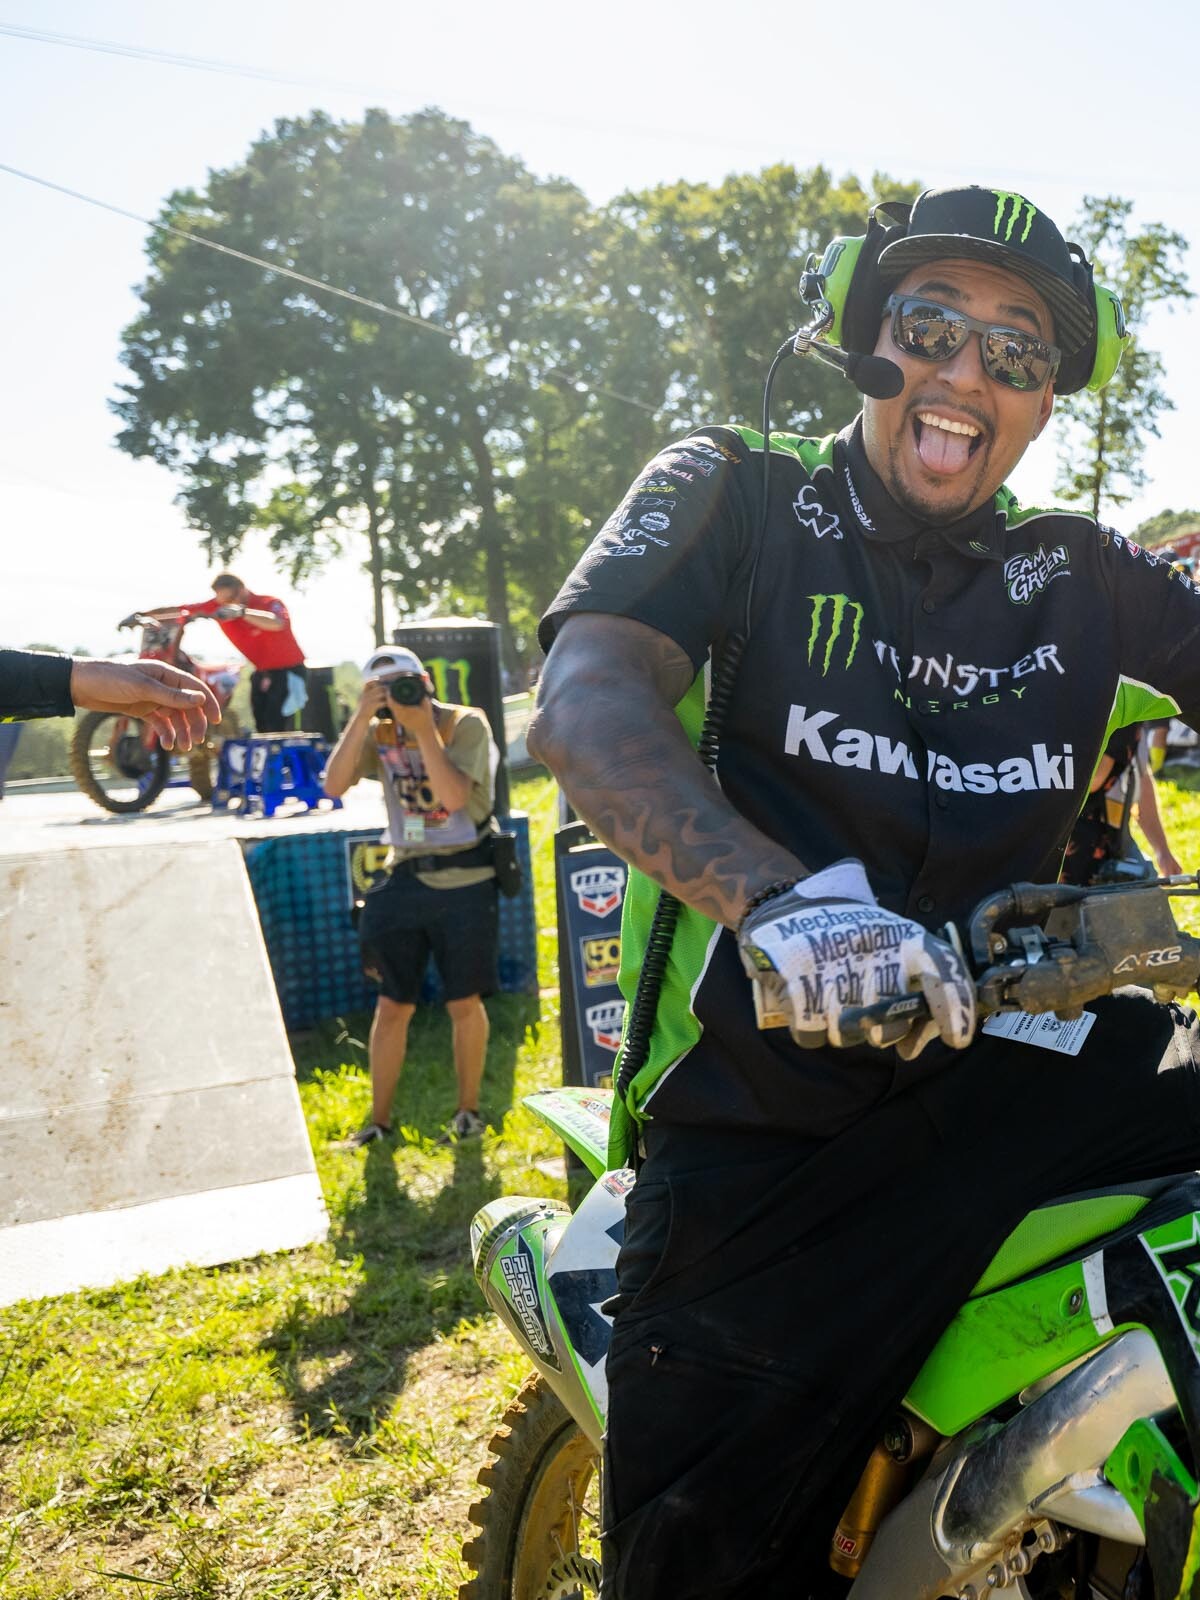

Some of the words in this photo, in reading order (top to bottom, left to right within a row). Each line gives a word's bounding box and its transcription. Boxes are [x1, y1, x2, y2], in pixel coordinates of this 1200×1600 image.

[1004, 546, 1046, 583] TEAM
[1010, 547, 1066, 601] GREEN
[894, 686, 1027, 713] NERGY
[784, 703, 1074, 795] Kawasaki
[774, 907, 892, 941] Mechanix
[804, 921, 922, 964] Mechanix
[1113, 946, 1182, 974] ARC
[799, 962, 900, 1014] Mchnix
[500, 1256, 546, 1353] CIRCUIT
[512, 1254, 538, 1310] PRO
